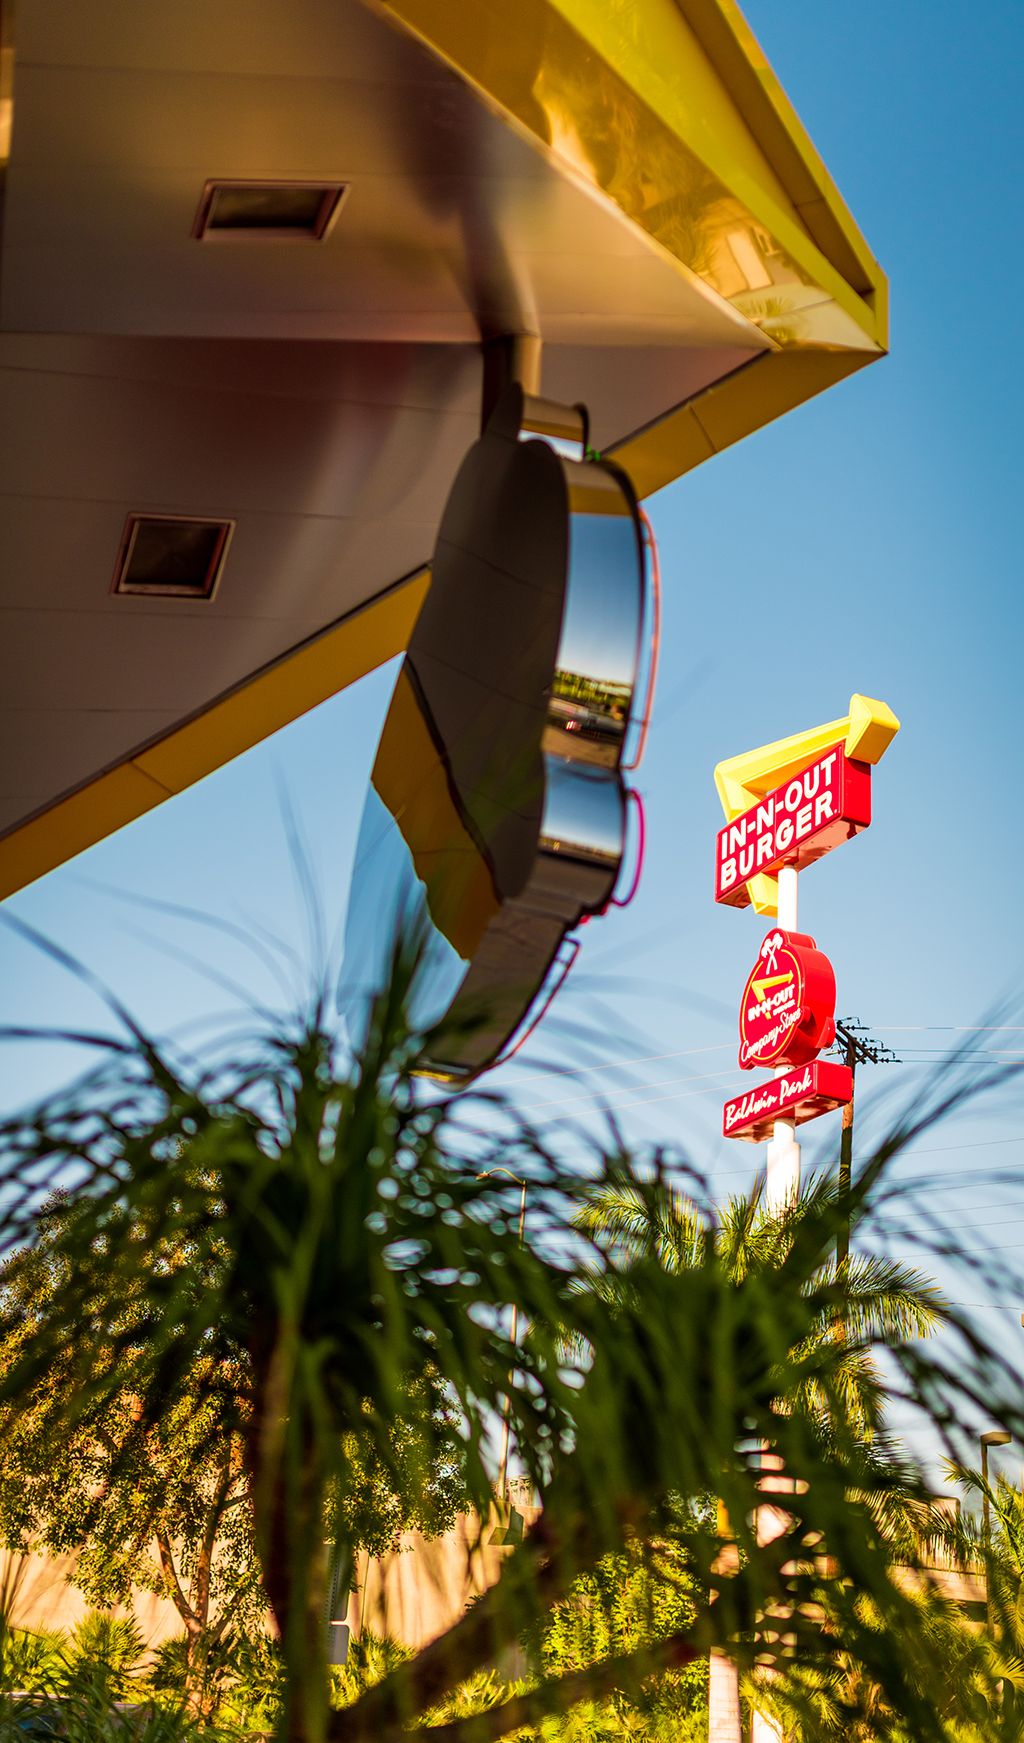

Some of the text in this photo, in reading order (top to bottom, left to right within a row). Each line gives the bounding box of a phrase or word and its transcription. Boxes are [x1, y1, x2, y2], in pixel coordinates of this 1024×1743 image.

[721, 752, 837, 861] IN-N-OUT
[720, 790, 834, 891] BURGER
[748, 984, 795, 1022] IN-N-OUT
[741, 1026, 780, 1063] Company
[726, 1067, 812, 1130] Baldwin Park
